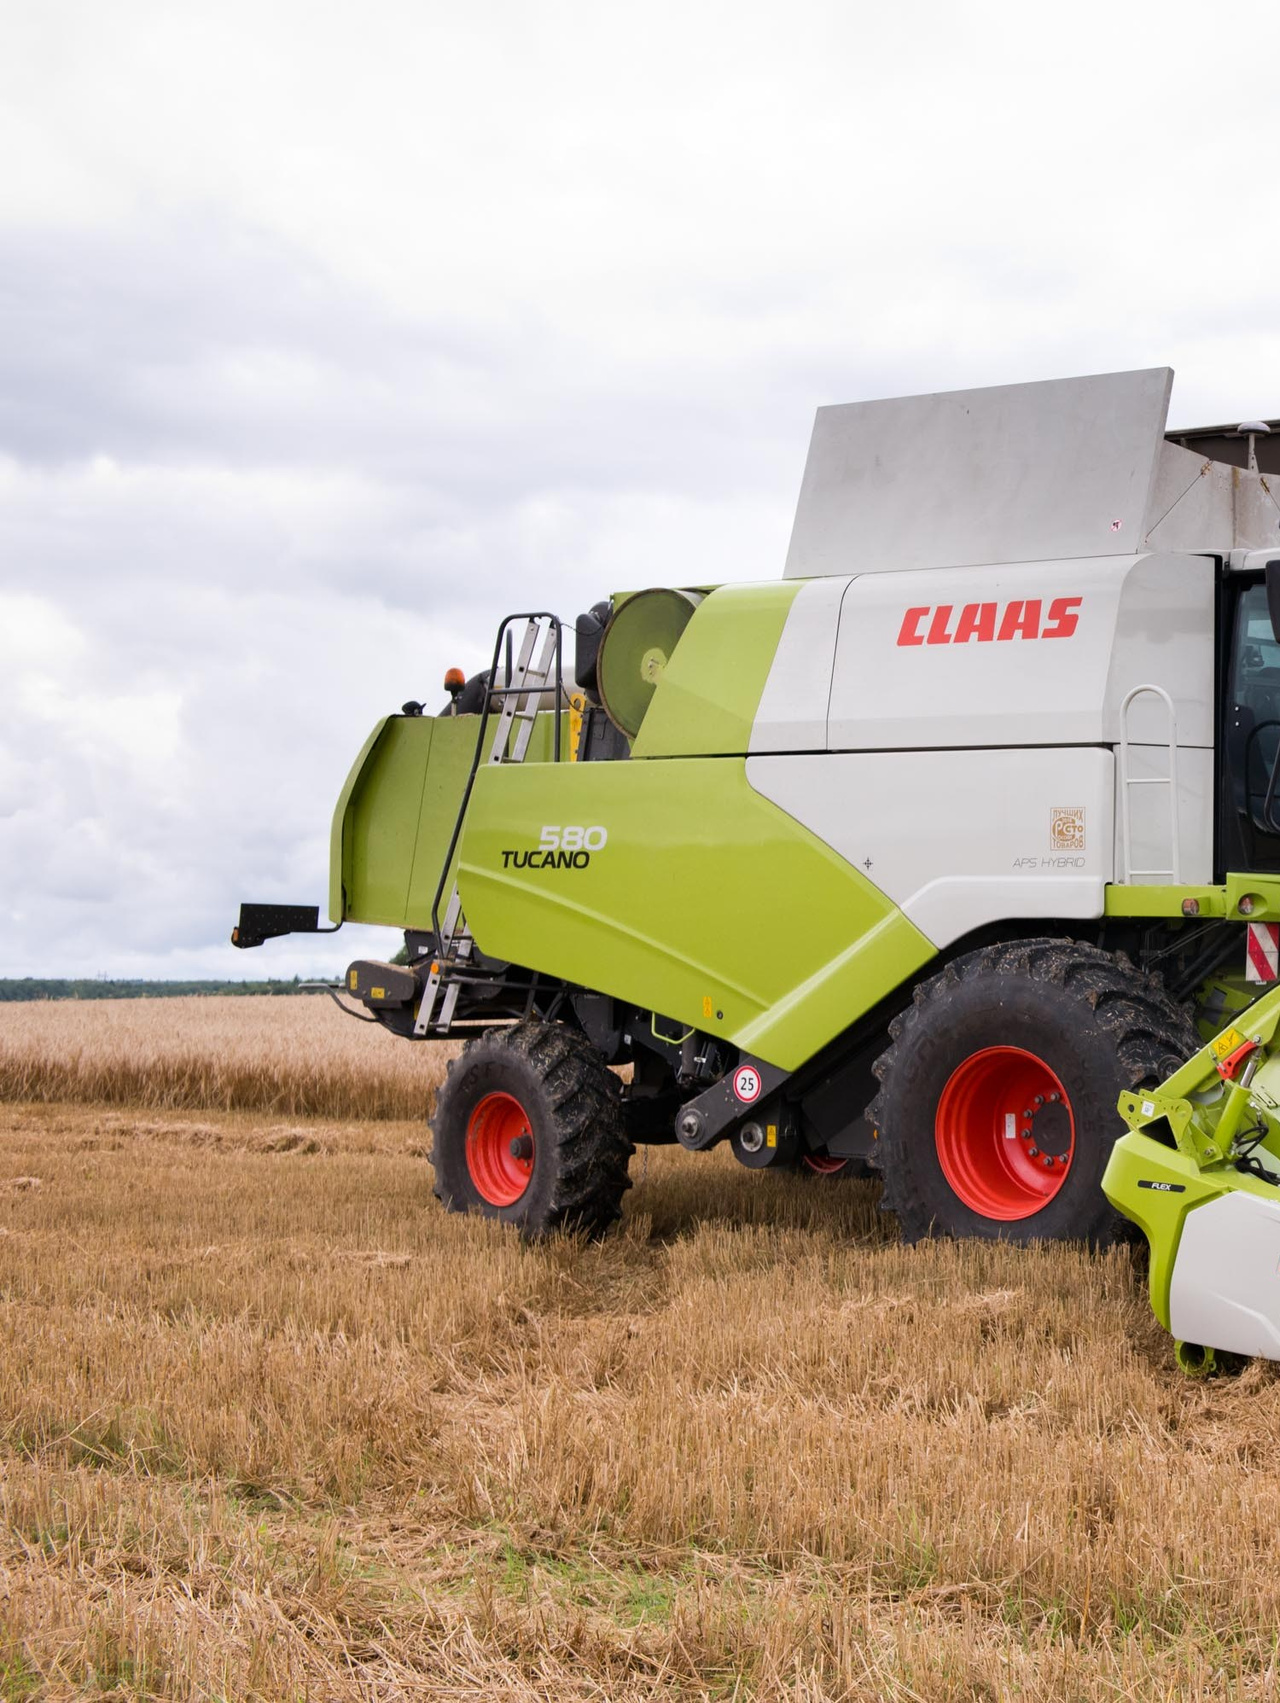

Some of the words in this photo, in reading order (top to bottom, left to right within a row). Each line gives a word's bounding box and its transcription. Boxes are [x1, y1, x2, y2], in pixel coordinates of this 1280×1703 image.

[897, 597, 1083, 646] CLAAS
[538, 825, 608, 851] 580
[501, 851, 590, 868] TUCANO
[1012, 858, 1038, 868] APS
[1041, 857, 1086, 868] HYBRID
[740, 1077, 754, 1091] 25
[1151, 1182, 1172, 1191] FLEX
